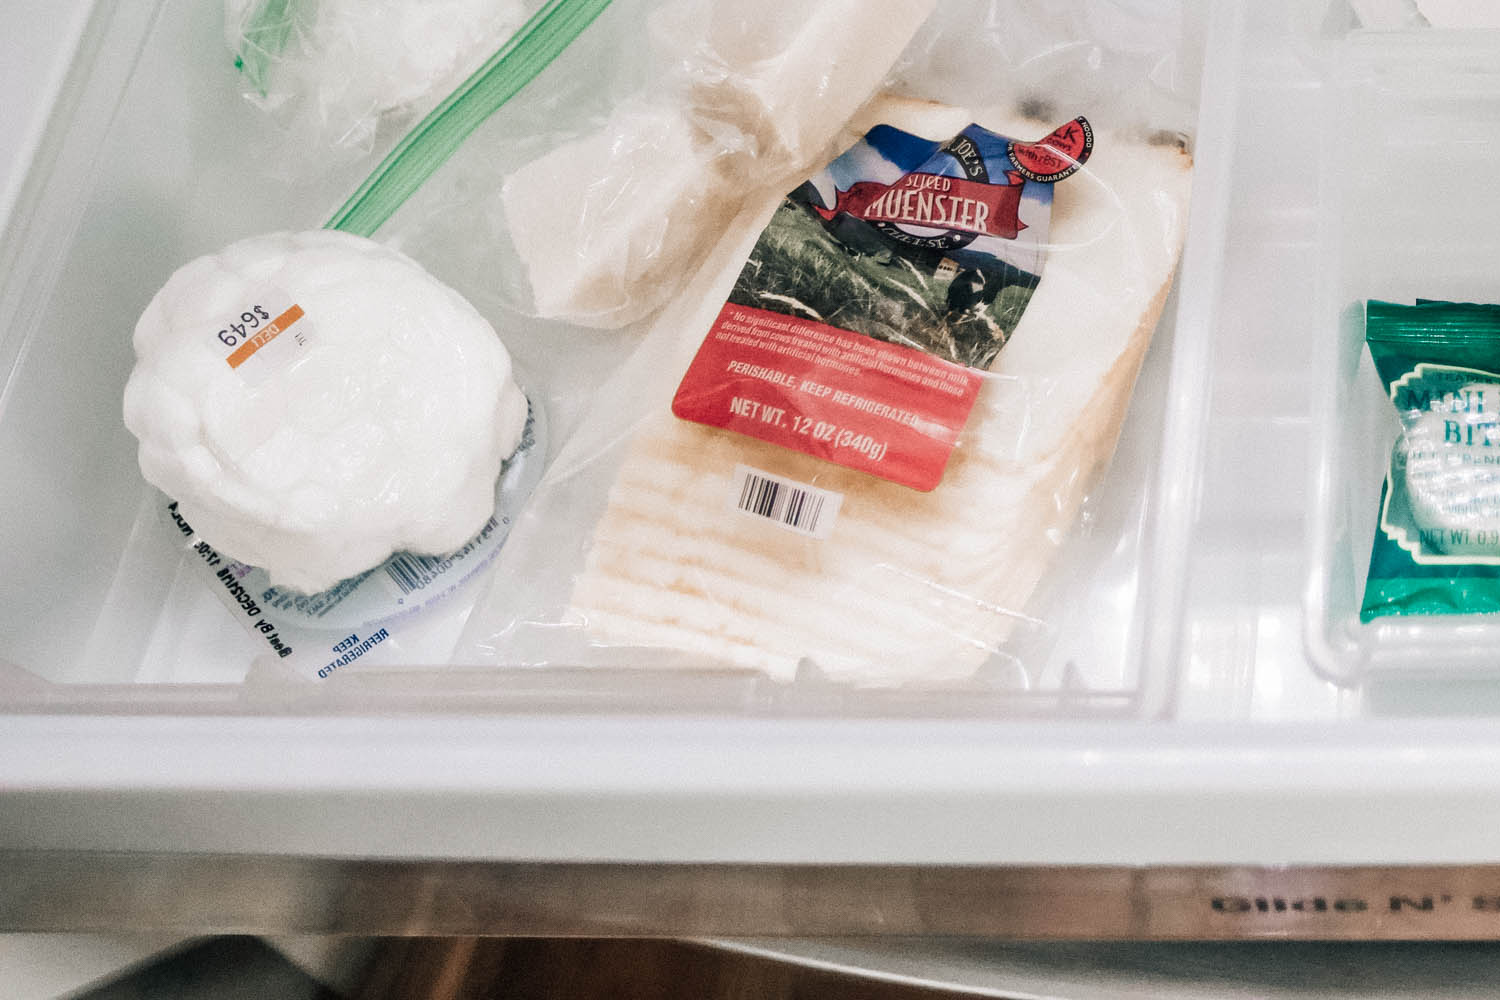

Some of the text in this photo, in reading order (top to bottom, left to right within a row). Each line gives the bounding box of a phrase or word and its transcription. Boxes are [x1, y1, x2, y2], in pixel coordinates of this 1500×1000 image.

[951, 139, 984, 177] JOE'S
[1008, 152, 1035, 180] FARMERS
[1036, 165, 1080, 182] GUARANT
[905, 173, 952, 192] SLICED
[864, 184, 990, 233] MUENSTER
[251, 322, 281, 348] DELI
[727, 360, 919, 426] PERISHABLE, KEEP REFRIGERATED
[730, 396, 888, 462] NET WT. 12 OZ (340g)
[1211, 894, 1369, 913] Glide
